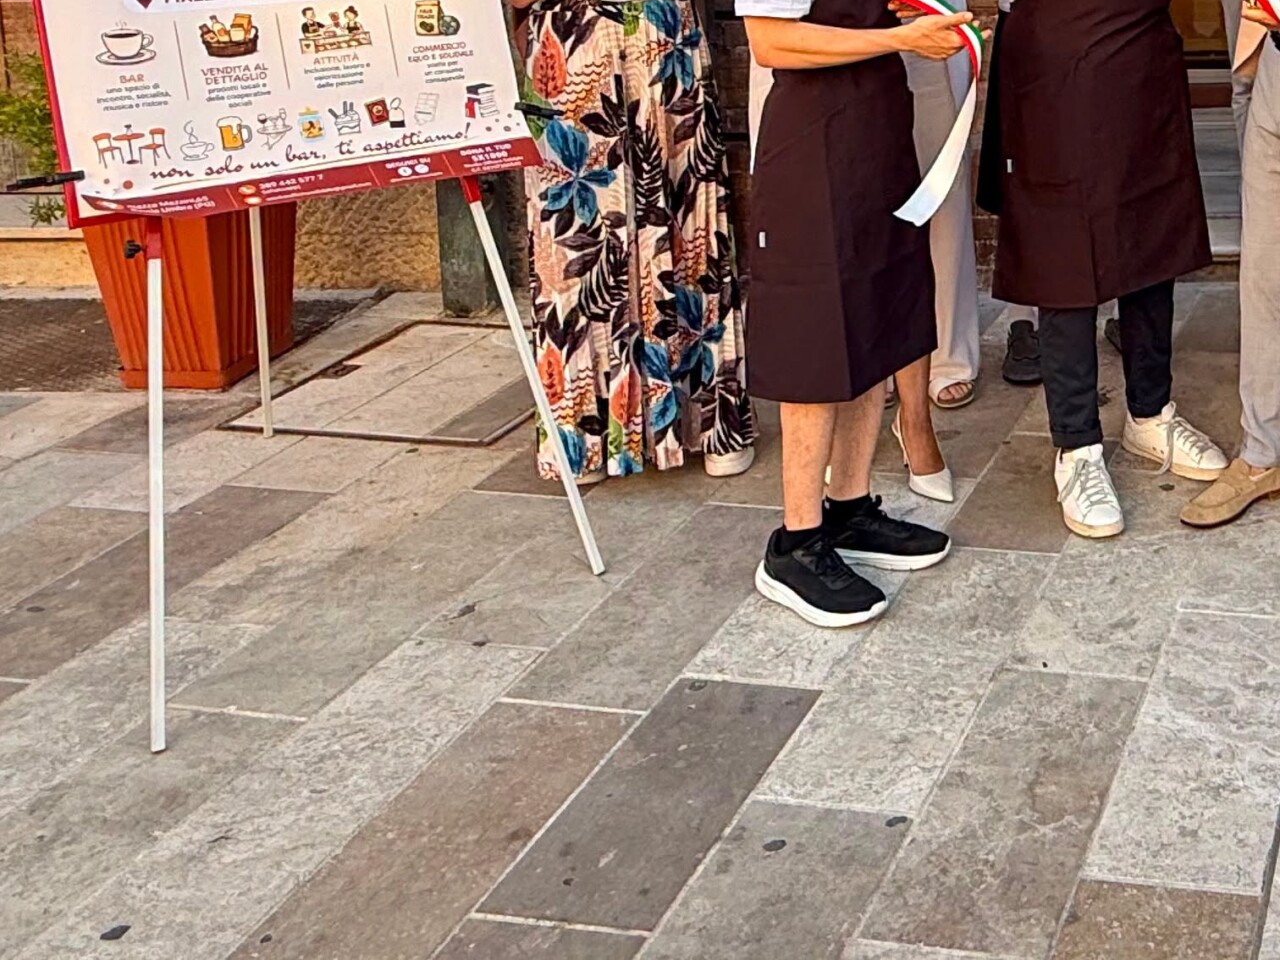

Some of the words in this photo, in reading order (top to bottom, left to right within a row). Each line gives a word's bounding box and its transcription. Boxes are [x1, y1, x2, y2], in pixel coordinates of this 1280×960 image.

[201, 64, 251, 76] VENDITA
[254, 63, 269, 71] AL
[119, 74, 145, 83] BAR
[205, 72, 267, 85] DETTAGLIO
[150, 168, 195, 179] non
[204, 154, 244, 176] solo
[250, 159, 280, 169] un
[285, 144, 327, 162] bar,
[335, 140, 356, 155] ti
[363, 122, 471, 154] aspettiamo!
